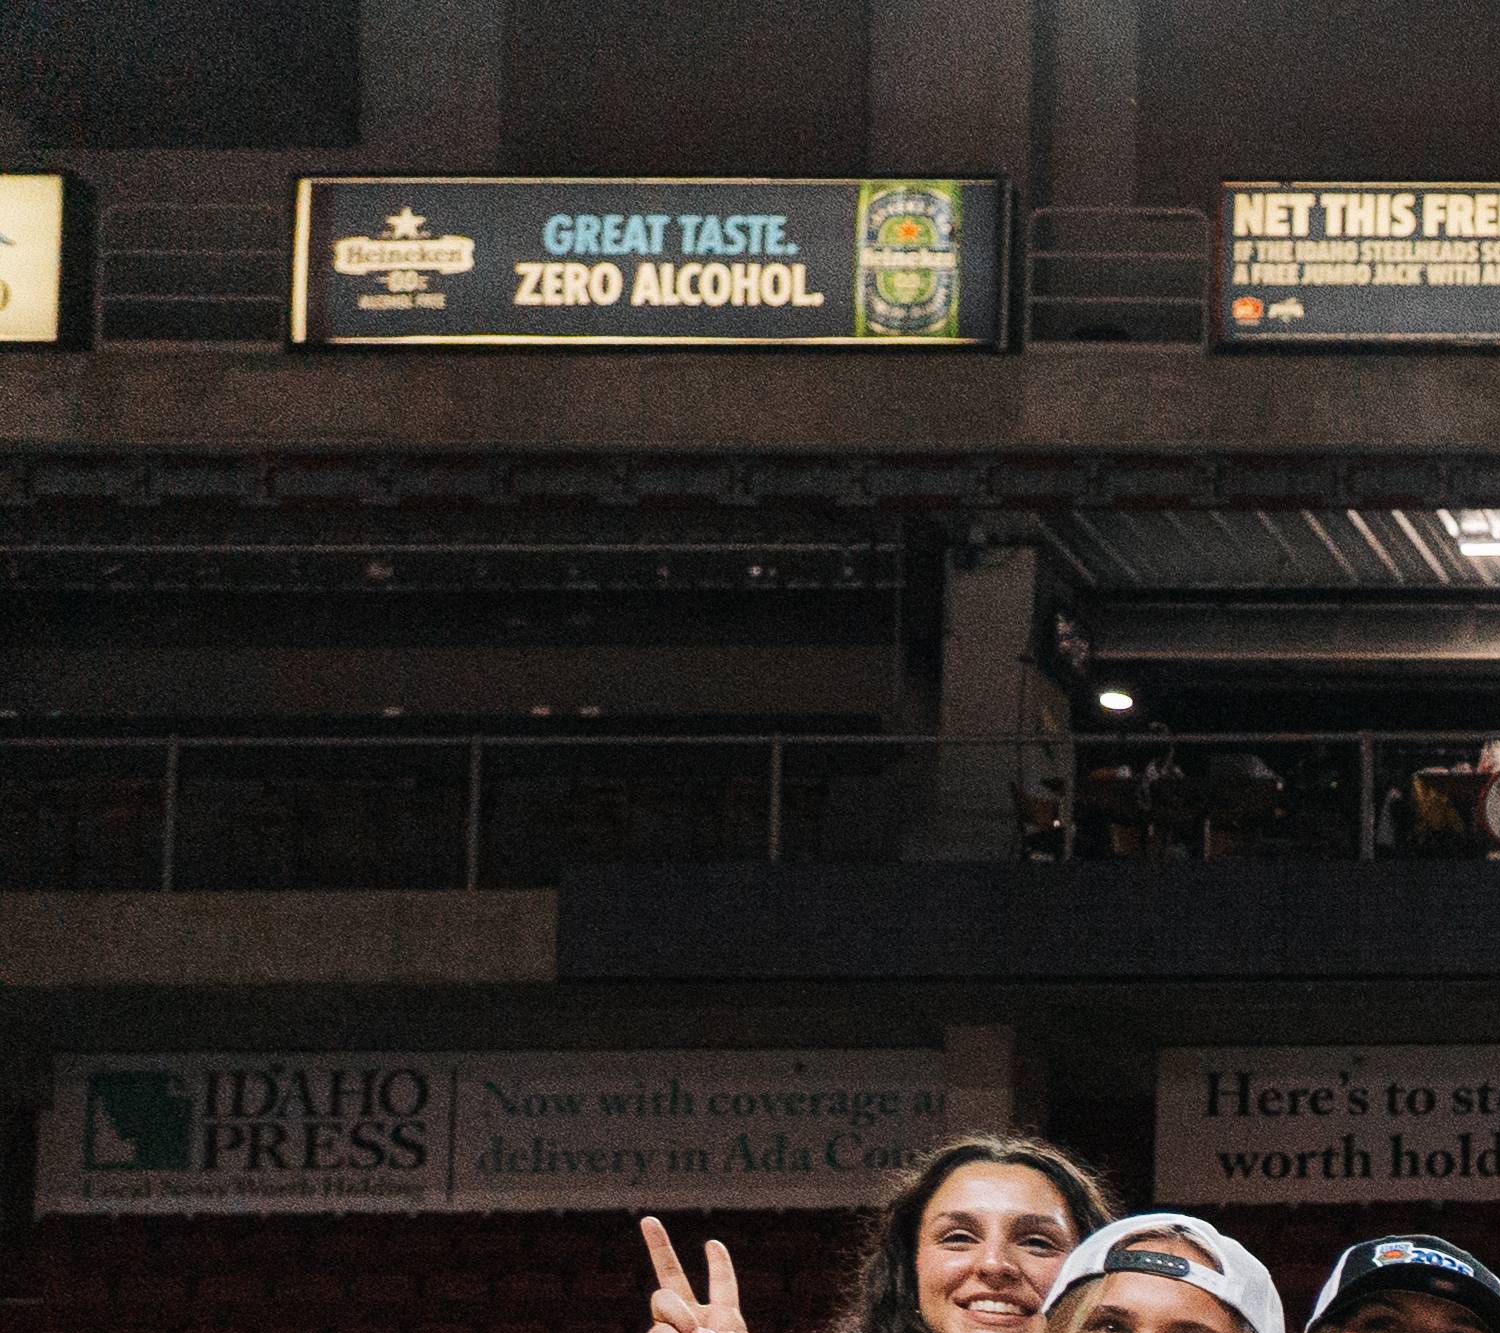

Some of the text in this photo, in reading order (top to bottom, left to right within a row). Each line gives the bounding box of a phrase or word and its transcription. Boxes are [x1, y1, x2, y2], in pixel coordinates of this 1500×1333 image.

[543, 214, 800, 256] GREAT TASTE.
[1232, 193, 1316, 237] NET
[1321, 193, 1417, 237] THIS
[345, 245, 463, 265] Heineken
[1256, 240, 1295, 263] THE
[514, 263, 824, 307] ZERO ALCOHOL.
[202, 1066, 431, 1120] IDAHO
[483, 1080, 582, 1120] Now
[600, 1078, 695, 1119] with
[708, 1087, 903, 1128] coverage
[1207, 1072, 1370, 1118] Here's
[1386, 1078, 1434, 1118] to
[202, 1120, 428, 1171] PRESS
[475, 1133, 814, 1183] delivery in Ada
[1218, 1133, 1376, 1181] worth
